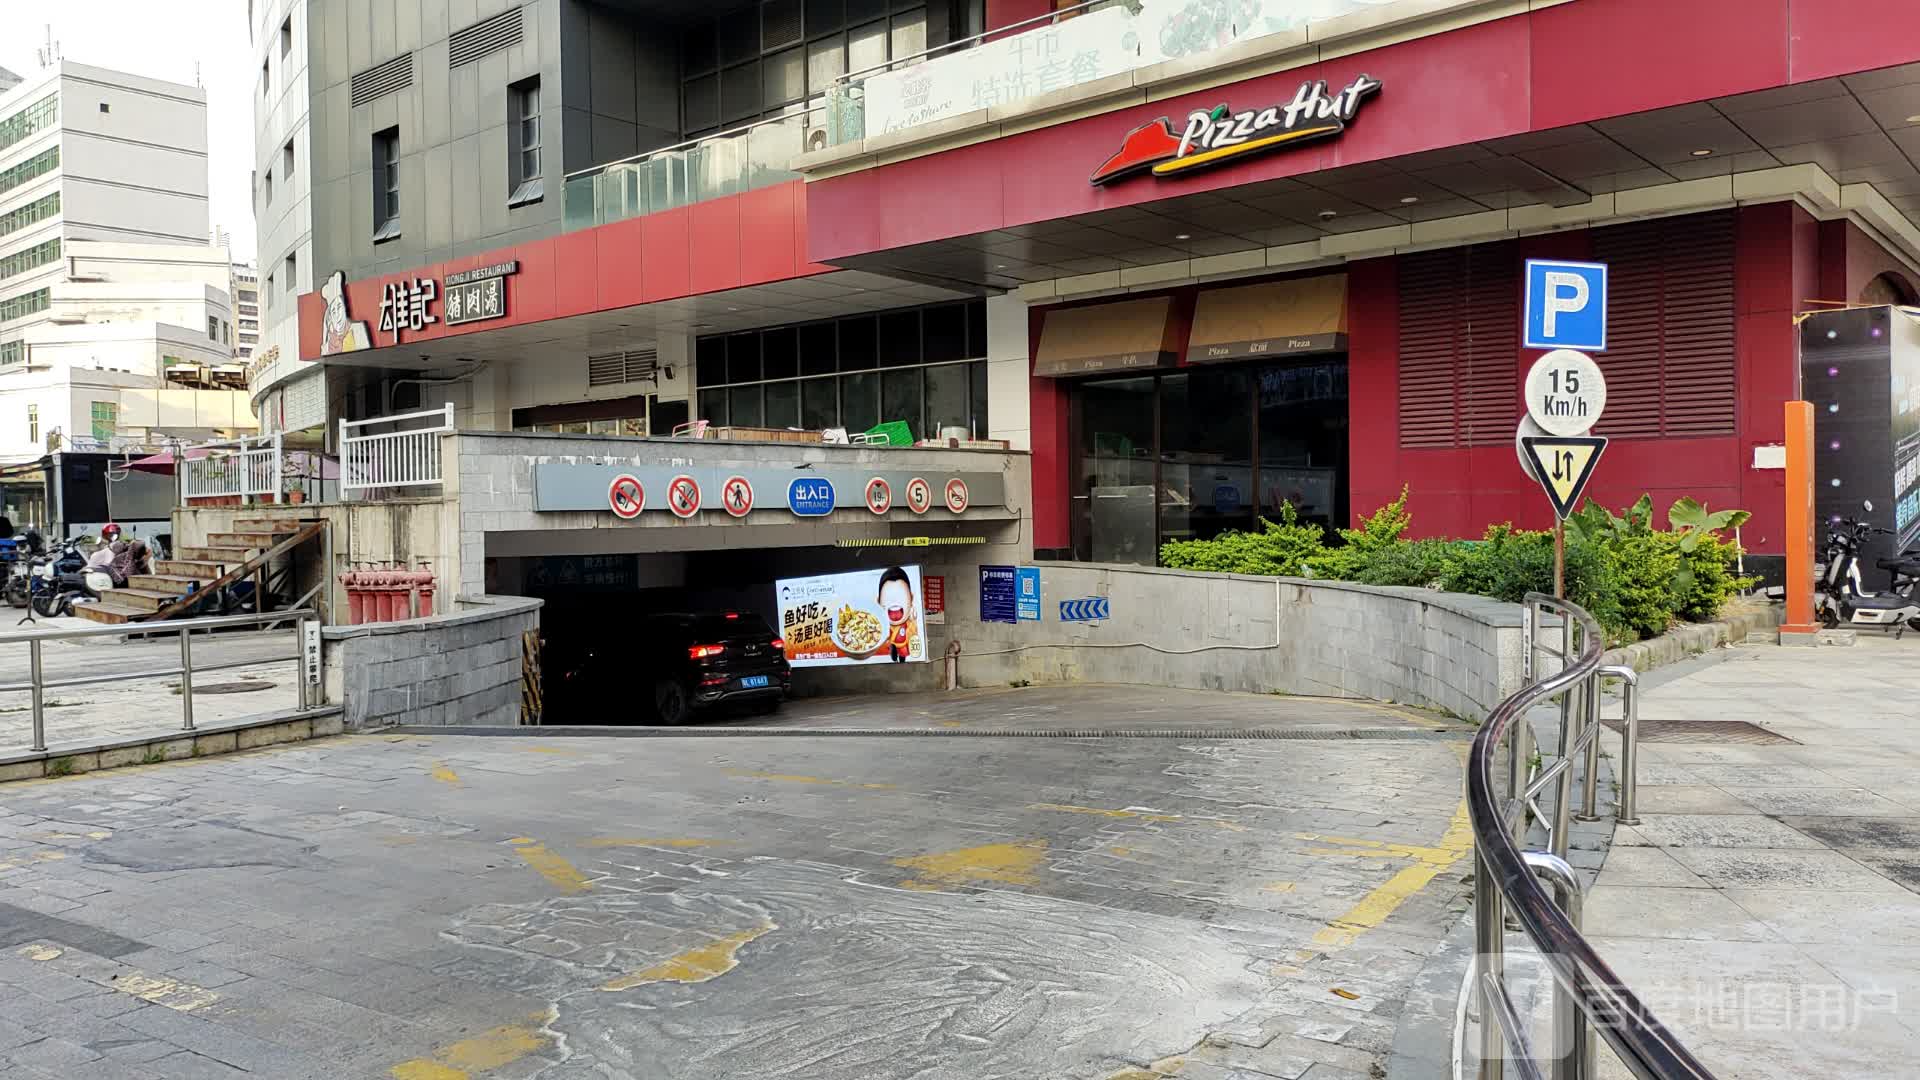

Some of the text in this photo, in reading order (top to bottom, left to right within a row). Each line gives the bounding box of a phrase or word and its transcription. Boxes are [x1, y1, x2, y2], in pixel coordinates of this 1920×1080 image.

[1177, 76, 1377, 158] Pizza Hut
[471, 261, 516, 281] RESTAURANT
[378, 277, 437, 344] 雄記
[1543, 271, 1590, 338] P
[1548, 368, 1580, 395] 15
[1543, 394, 1588, 418] Km/h
[795, 485, 829, 500] 出入口
[796, 500, 830, 509] ENTRANCE
[915, 487, 923, 504] 5
